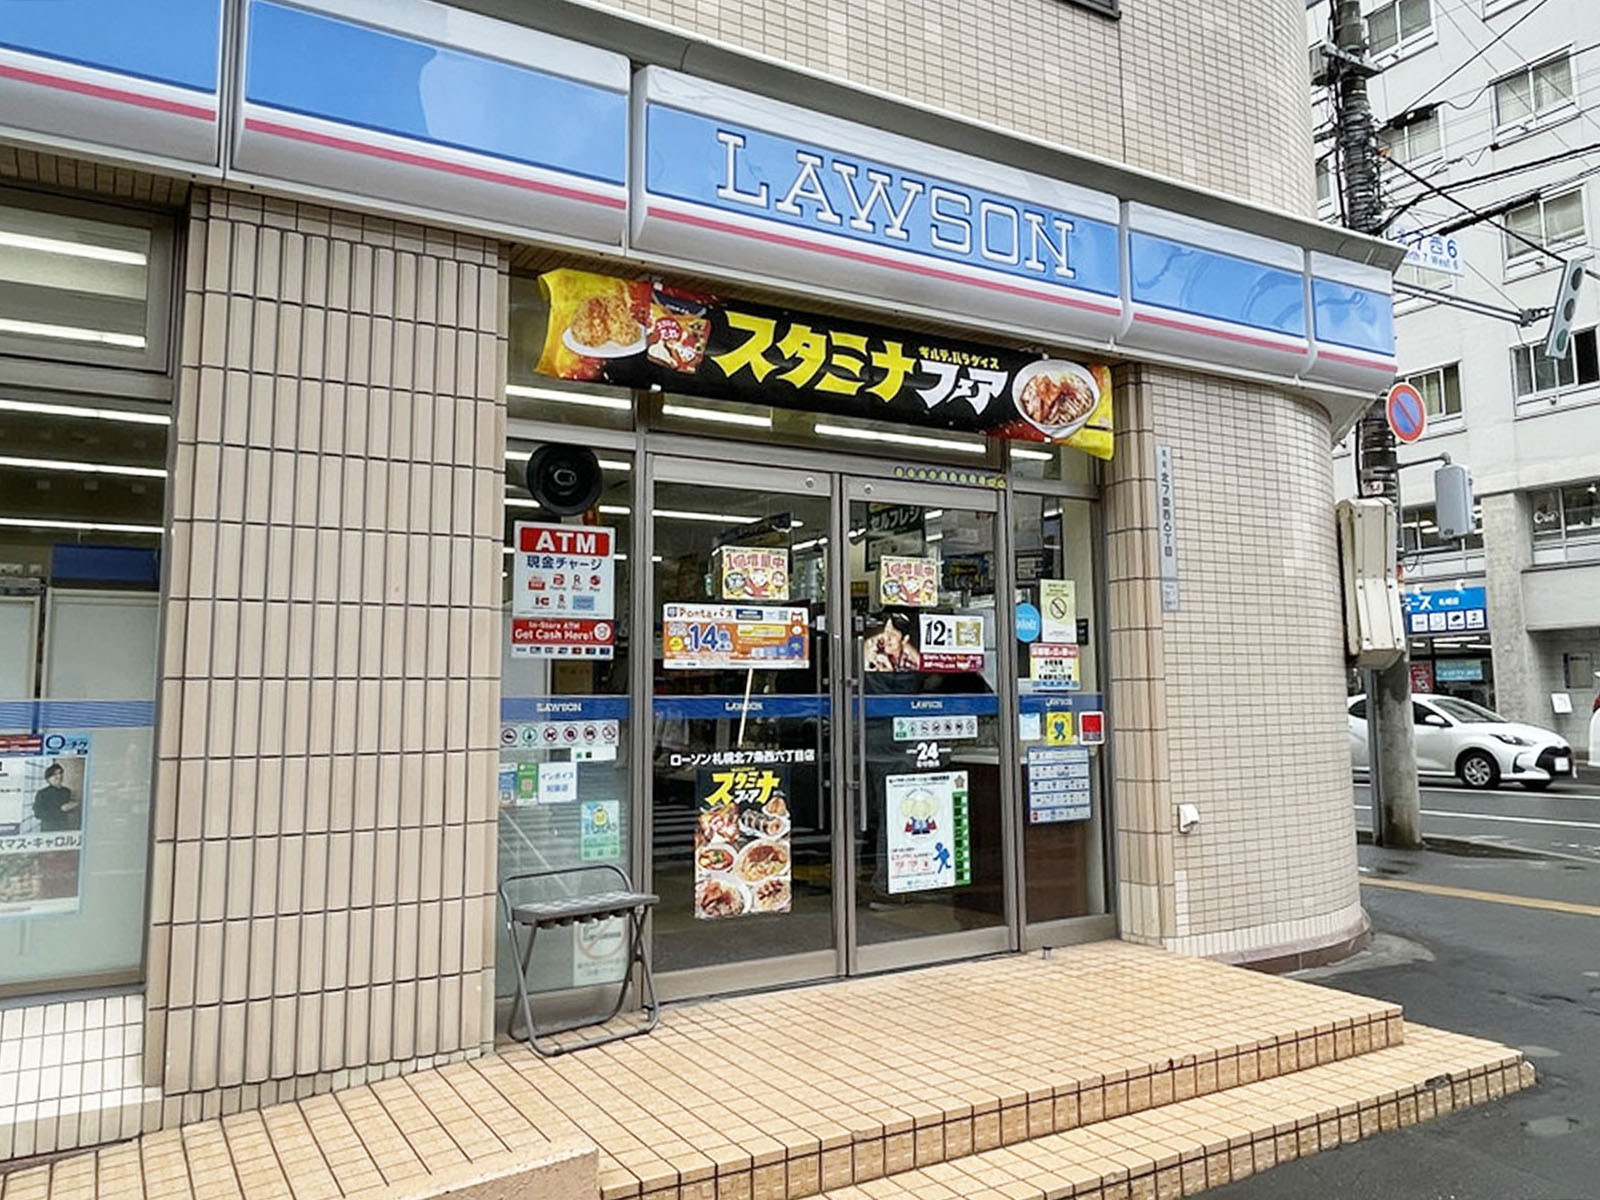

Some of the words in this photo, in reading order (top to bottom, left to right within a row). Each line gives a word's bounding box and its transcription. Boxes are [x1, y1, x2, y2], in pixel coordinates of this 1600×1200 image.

[716, 129, 1075, 279] LAWSON
[535, 531, 596, 554] ATM
[527, 555, 602, 571] 現金チャージ
[515, 629, 533, 639] Get
[536, 630, 562, 640] Cash
[564, 630, 593, 641] Here!
[925, 620, 946, 646] 12
[536, 702, 582, 712] LAWSON
[917, 742, 939, 760] 24
[0, 835, 82, 849] マス・キャロル』
